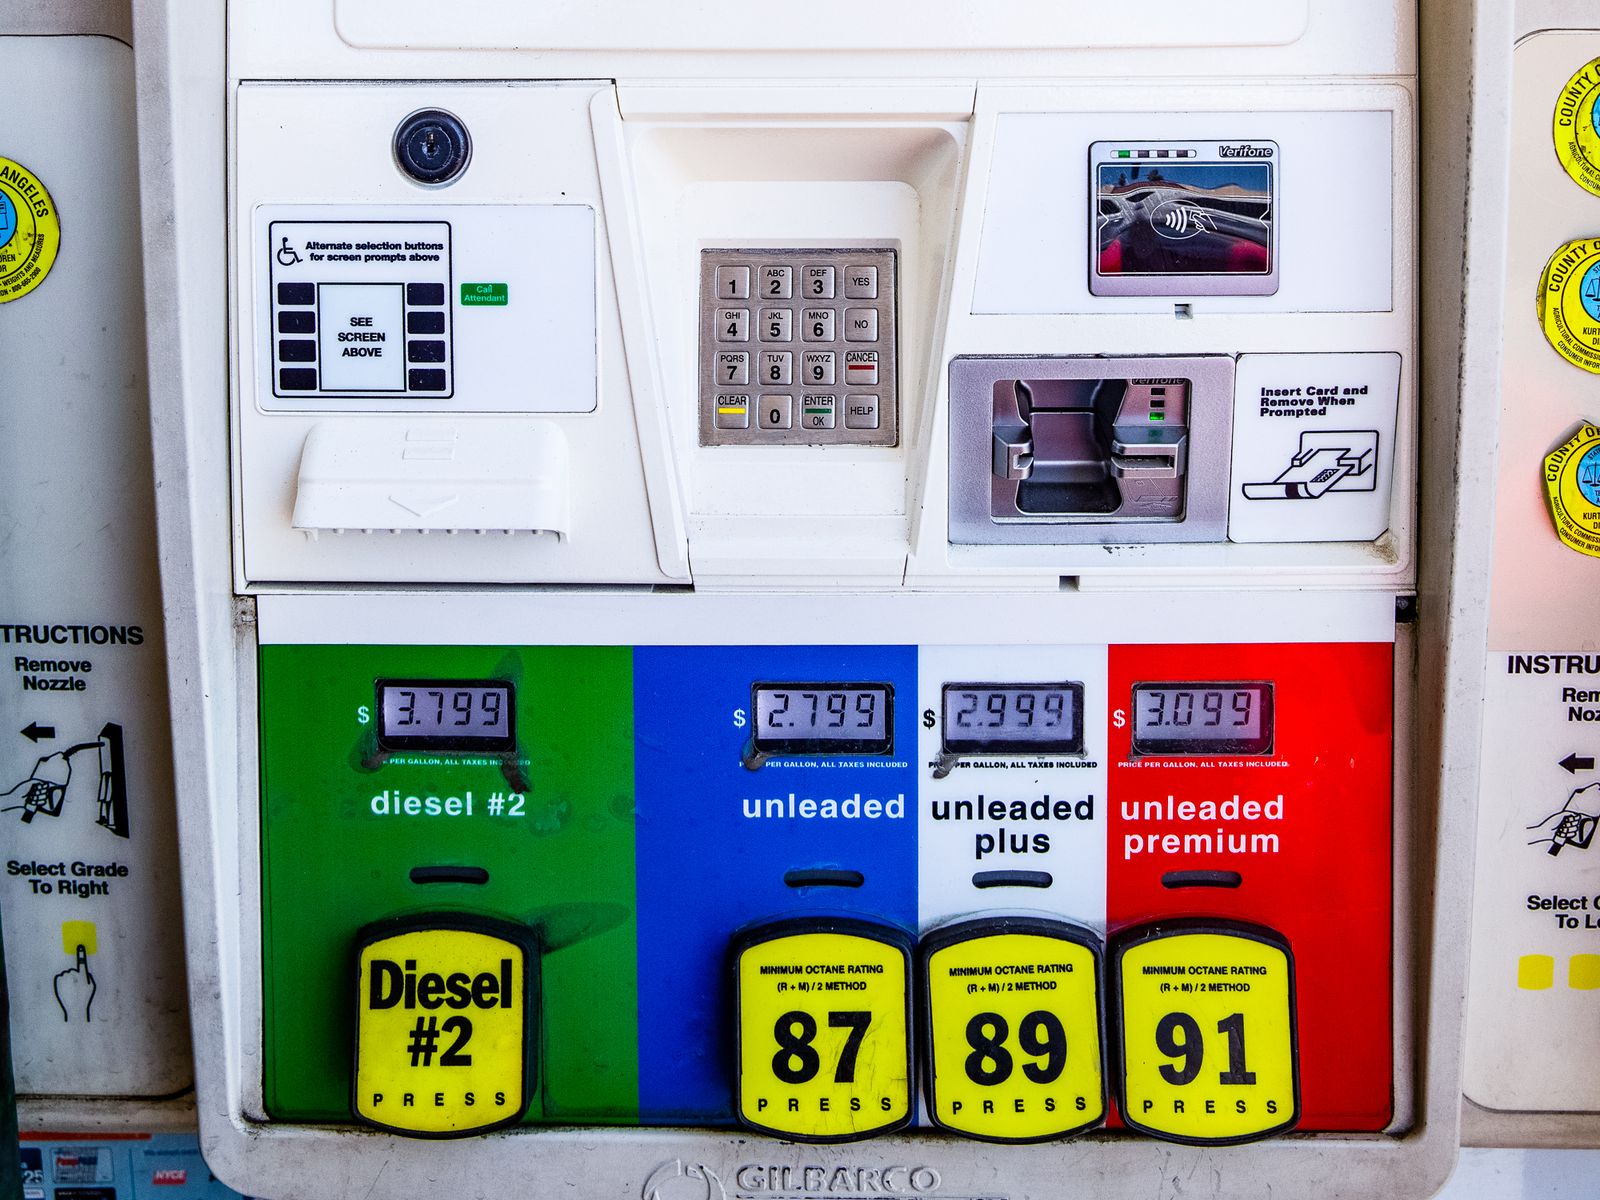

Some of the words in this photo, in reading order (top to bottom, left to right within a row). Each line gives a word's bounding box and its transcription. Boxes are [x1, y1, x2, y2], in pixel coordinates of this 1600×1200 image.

[1559, 72, 1592, 126] COUNTY
[1219, 146, 1273, 158] Verifone
[0, 166, 49, 218] ANGELES
[305, 241, 352, 250] Alternate
[355, 241, 402, 250] selection
[404, 241, 444, 250] buttons
[2, 271, 26, 286] WEIGHTS
[24, 262, 35, 273] AND
[31, 234, 45, 263] MEASURES
[309, 253, 324, 261] for
[364, 253, 406, 263] prompts
[409, 253, 439, 261] above
[767, 269, 785, 277] ABC
[810, 269, 827, 277] DEF
[1548, 243, 1587, 292] COUNTY
[729, 280, 737, 294] 1
[770, 280, 781, 294] 2
[813, 280, 824, 294] 3
[852, 277, 870, 286] YES
[476, 285, 493, 293] Call
[350, 317, 373, 327] SEE
[725, 312, 741, 320] GHI
[768, 312, 783, 320] JKL
[808, 312, 828, 320] MNO
[727, 323, 738, 336] 4
[770, 323, 780, 337] 5
[813, 323, 824, 337] 6
[854, 320, 868, 329] NO
[338, 332, 385, 342] SCREEN
[342, 348, 382, 357] ABOVE
[846, 353, 877, 362] CANCEL
[1558, 340, 1584, 363] CONSUMER
[720, 355, 745, 363] PQRS
[768, 355, 785, 363] TUV
[806, 355, 831, 363] WXYZ
[727, 366, 738, 380] 7
[770, 366, 781, 380] 8
[813, 366, 824, 380] 9
[1261, 387, 1301, 396] Insert
[1306, 386, 1338, 395] Card
[1343, 385, 1368, 395] and
[718, 396, 747, 405] CLEAR
[804, 396, 833, 405] ENTER
[1260, 397, 1314, 406] Remove
[1318, 396, 1355, 405] When
[769, 409, 780, 424] 0
[850, 406, 873, 415] HELP
[1260, 407, 1327, 418] Prompted
[813, 416, 825, 426] OK
[0, 625, 144, 645] TRUCTIONS
[15, 657, 92, 673] Remove
[1508, 655, 1600, 674] INSTRU
[23, 676, 86, 691] Nozzle
[357, 706, 370, 725] $
[397, 691, 501, 726] 3.799
[733, 708, 746, 729] $
[768, 693, 875, 728] 2.799
[923, 708, 936, 730] $
[957, 694, 1063, 728] 2.999
[1112, 709, 1126, 729] $
[1146, 692, 1251, 727] 3.099
[371, 791, 472, 816] diesel
[488, 792, 525, 816] #2
[743, 794, 905, 818] unleaded
[932, 795, 1094, 820] unleaded
[1121, 795, 1284, 820] unleaded
[976, 828, 1050, 860] plus
[1124, 828, 1279, 860] premium
[7, 861, 66, 877] Select
[71, 862, 128, 878] Grade
[29, 879, 54, 895] To
[58, 880, 109, 897] Right
[1527, 895, 1588, 910] Select
[1555, 914, 1579, 929] To
[760, 965, 802, 975] MINIMUM
[805, 965, 845, 974] OCTANE
[848, 964, 884, 974] RATING
[949, 967, 992, 977] MINIMUM
[995, 965, 1035, 975] OCTANE
[1037, 964, 1073, 973] RATING
[1142, 966, 1186, 975] MINIMUM
[1188, 966, 1228, 975] OCTANE
[1230, 966, 1267, 975] RATING
[369, 959, 512, 1010] Diesel
[817, 982, 823, 991] 2
[826, 981, 867, 991] METHOD
[1007, 982, 1013, 991] 2
[1015, 981, 1057, 991] METHOD
[1200, 983, 1206, 992] 2
[1209, 983, 1250, 992] METHOD
[407, 1015, 473, 1067] #2
[771, 1011, 872, 1084] 87
[965, 1010, 1067, 1086] 89
[1155, 1011, 1256, 1086] 91
[373, 1092, 505, 1107] PRESS
[758, 1097, 891, 1112] PRESS
[952, 1096, 1086, 1114] PRESS
[1143, 1099, 1277, 1114] PRESS
[737, 1164, 942, 1192] GILBARCO
